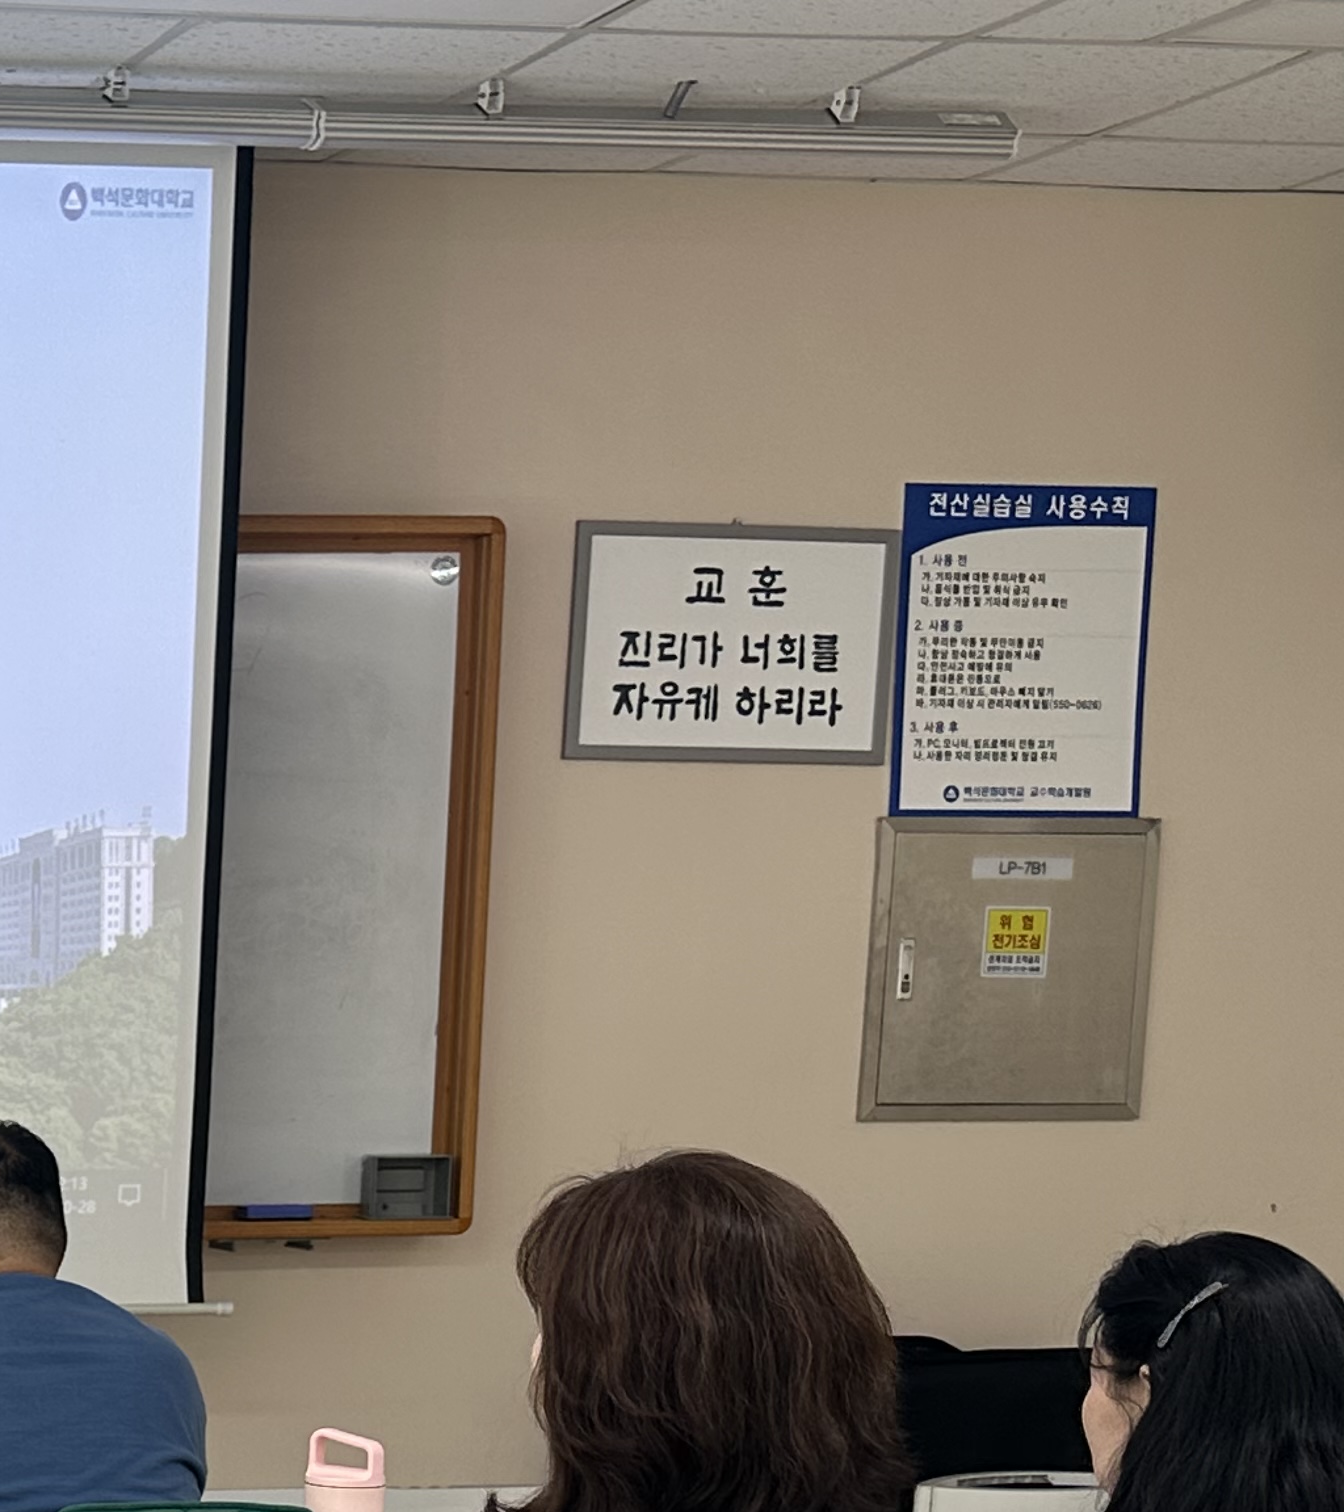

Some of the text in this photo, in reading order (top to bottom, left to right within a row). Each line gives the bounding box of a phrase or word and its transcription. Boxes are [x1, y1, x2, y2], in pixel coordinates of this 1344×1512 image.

[90, 187, 194, 209] 백석문화대학교
[928, 492, 1130, 521] 전산실습실 사용수칙
[932, 553, 952, 567] 사용
[929, 619, 949, 632] 사용
[618, 631, 839, 673] 진리가 너희를
[612, 681, 843, 726] 자유케 하리라
[924, 720, 944, 733] 사용
[963, 786, 1024, 797] 백석문화대학교
[999, 861, 1047, 875] LP-7B1
[992, 934, 1041, 950] 전기조심
